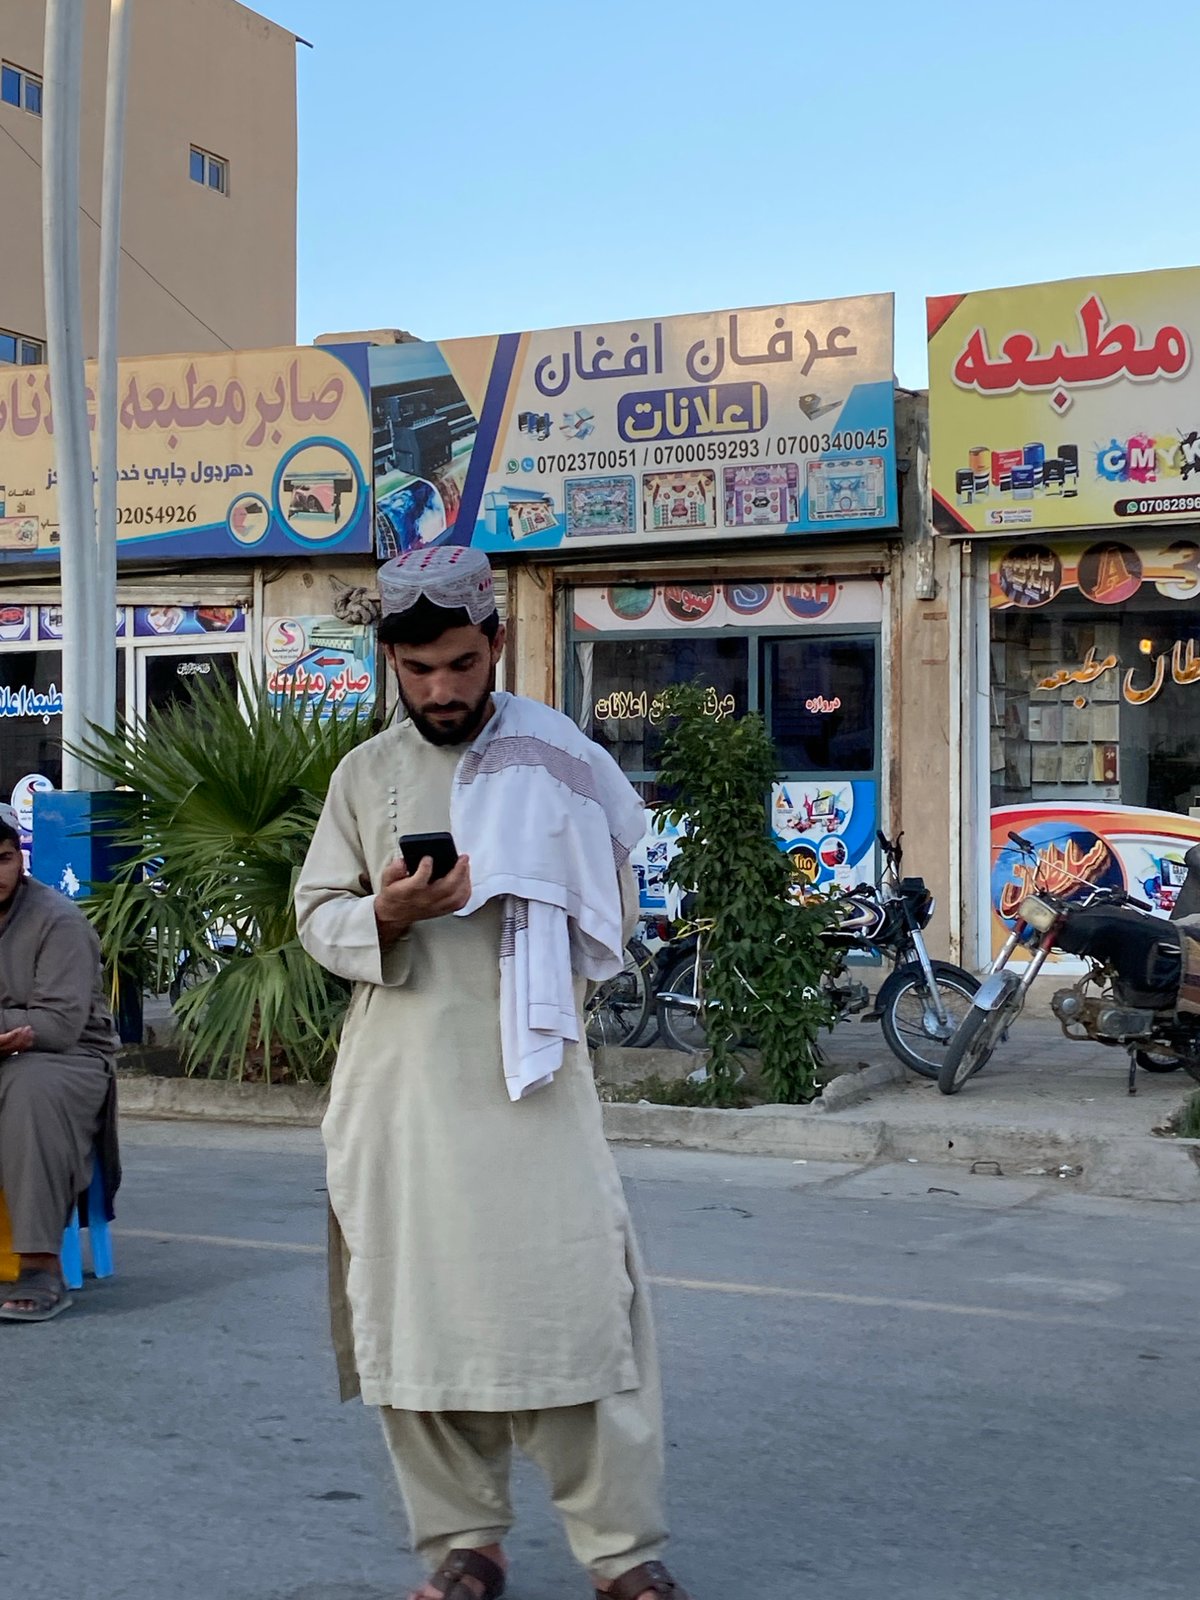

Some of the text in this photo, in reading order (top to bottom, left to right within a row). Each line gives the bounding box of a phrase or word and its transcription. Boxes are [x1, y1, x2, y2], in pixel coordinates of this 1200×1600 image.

[534, 313, 858, 397] عرفان افغان
[954, 295, 1187, 409] مطبعه
[120, 363, 245, 449] مطبعه
[246, 359, 344, 447] صابر
[624, 384, 763, 439] اعلانات
[537, 448, 636, 475] 0702370051
[654, 440, 759, 465] 0700059293
[777, 429, 888, 454] 0700340045
[93, 504, 197, 526] 02054926
[326, 667, 371, 702] صابر
[1036, 646, 1117, 709] مطبعه
[27, 684, 63, 724] طبعه
[594, 690, 647, 720] اعلانات
[805, 695, 841, 713] دروازه
